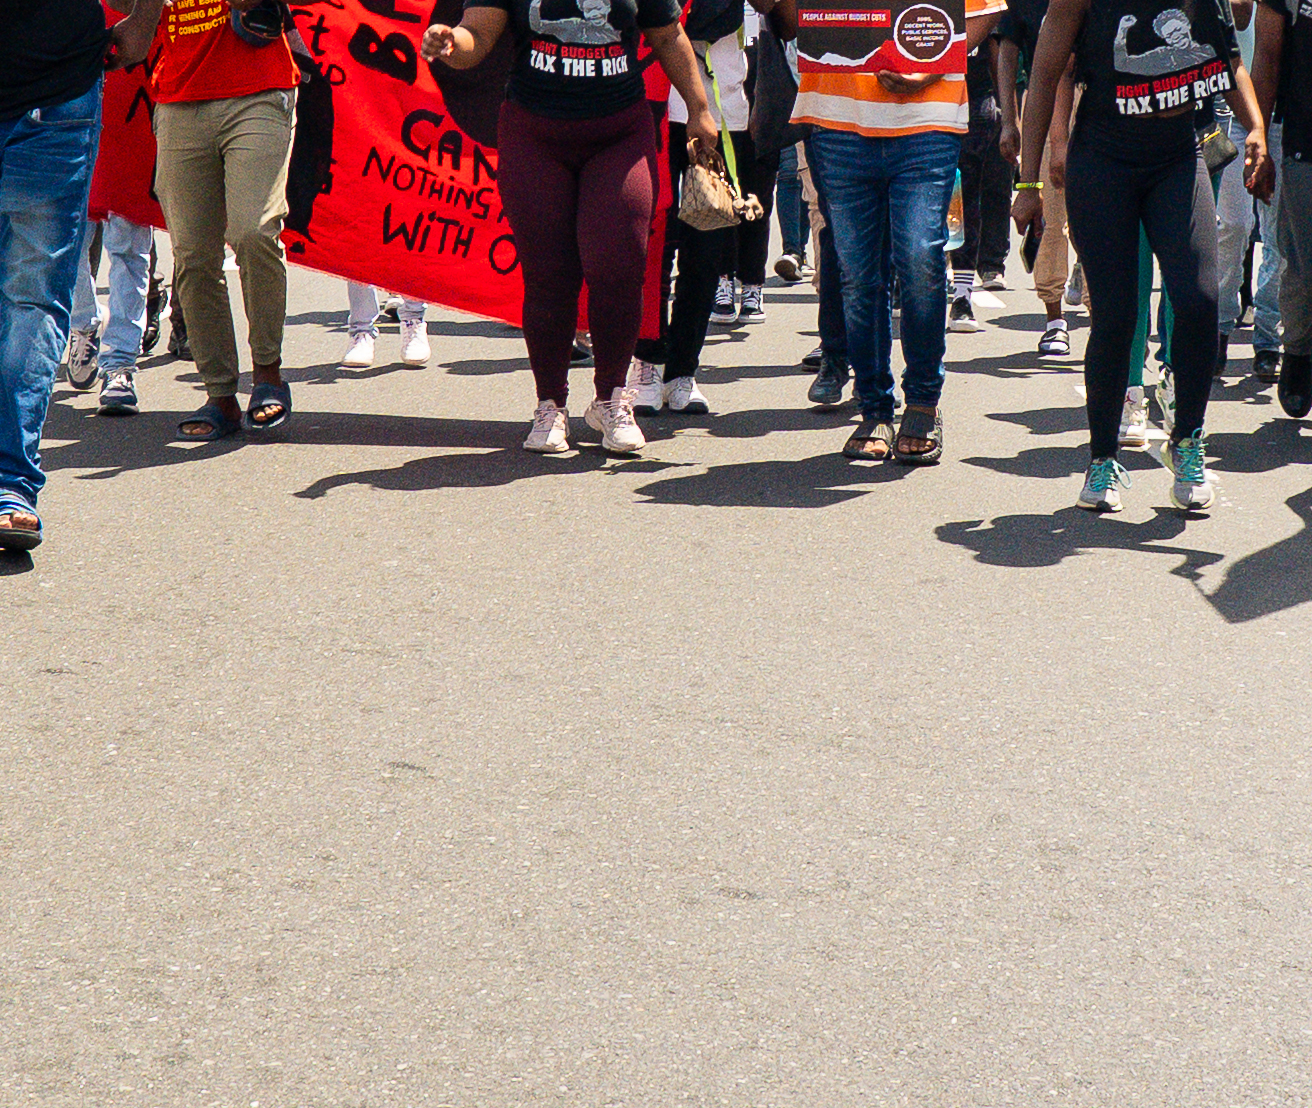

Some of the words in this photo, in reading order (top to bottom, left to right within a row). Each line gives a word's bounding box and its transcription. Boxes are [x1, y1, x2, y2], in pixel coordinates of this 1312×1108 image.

[802, 13, 824, 21] PEOPLE
[871, 13, 886, 21] CUTS
[530, 49, 557, 73] TAX
[561, 58, 596, 77] THE
[601, 54, 629, 77] RICH
[561, 44, 606, 59] BUDGET
[1116, 82, 1150, 98] FIGHT
[1152, 69, 1199, 93] BUDGET
[1116, 95, 1153, 115] TAX
[1155, 84, 1190, 110] THE
[1193, 71, 1231, 99] RICH
